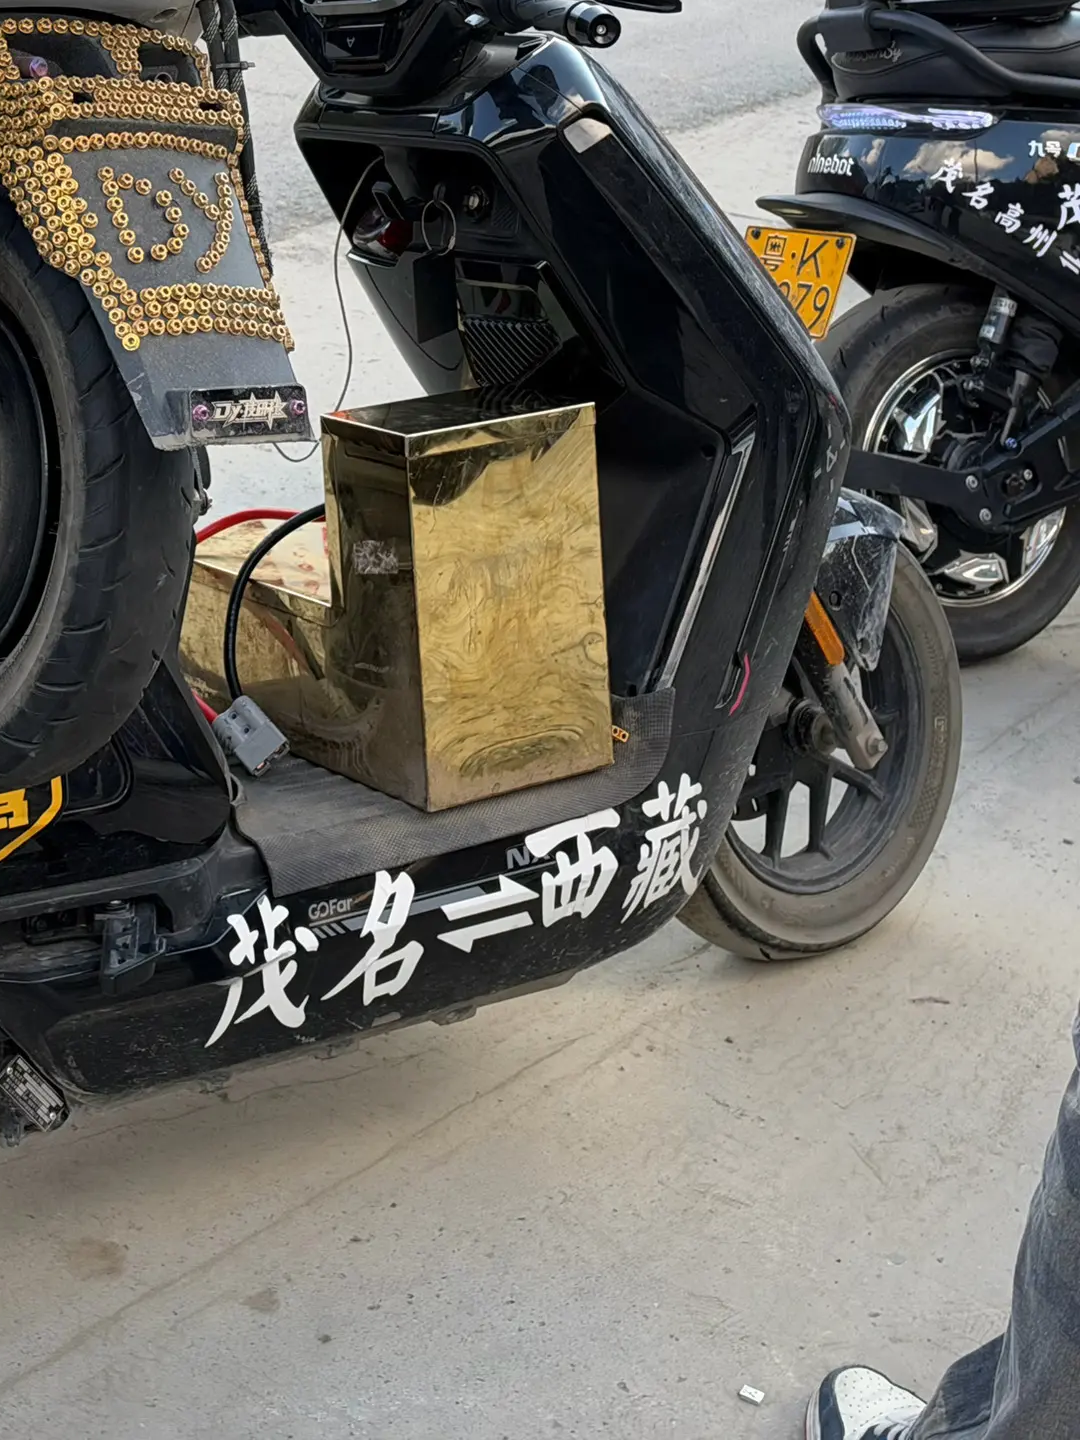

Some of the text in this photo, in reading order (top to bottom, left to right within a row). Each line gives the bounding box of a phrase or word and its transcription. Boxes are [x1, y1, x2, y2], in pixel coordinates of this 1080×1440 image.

[1028, 140, 1062, 158] 九号
[807, 154, 854, 176] ninebot
[930, 157, 1058, 258] 茂名高州
[205, 773, 708, 1048] 茂名 西藏
[308, 895, 354, 918] GOFar
